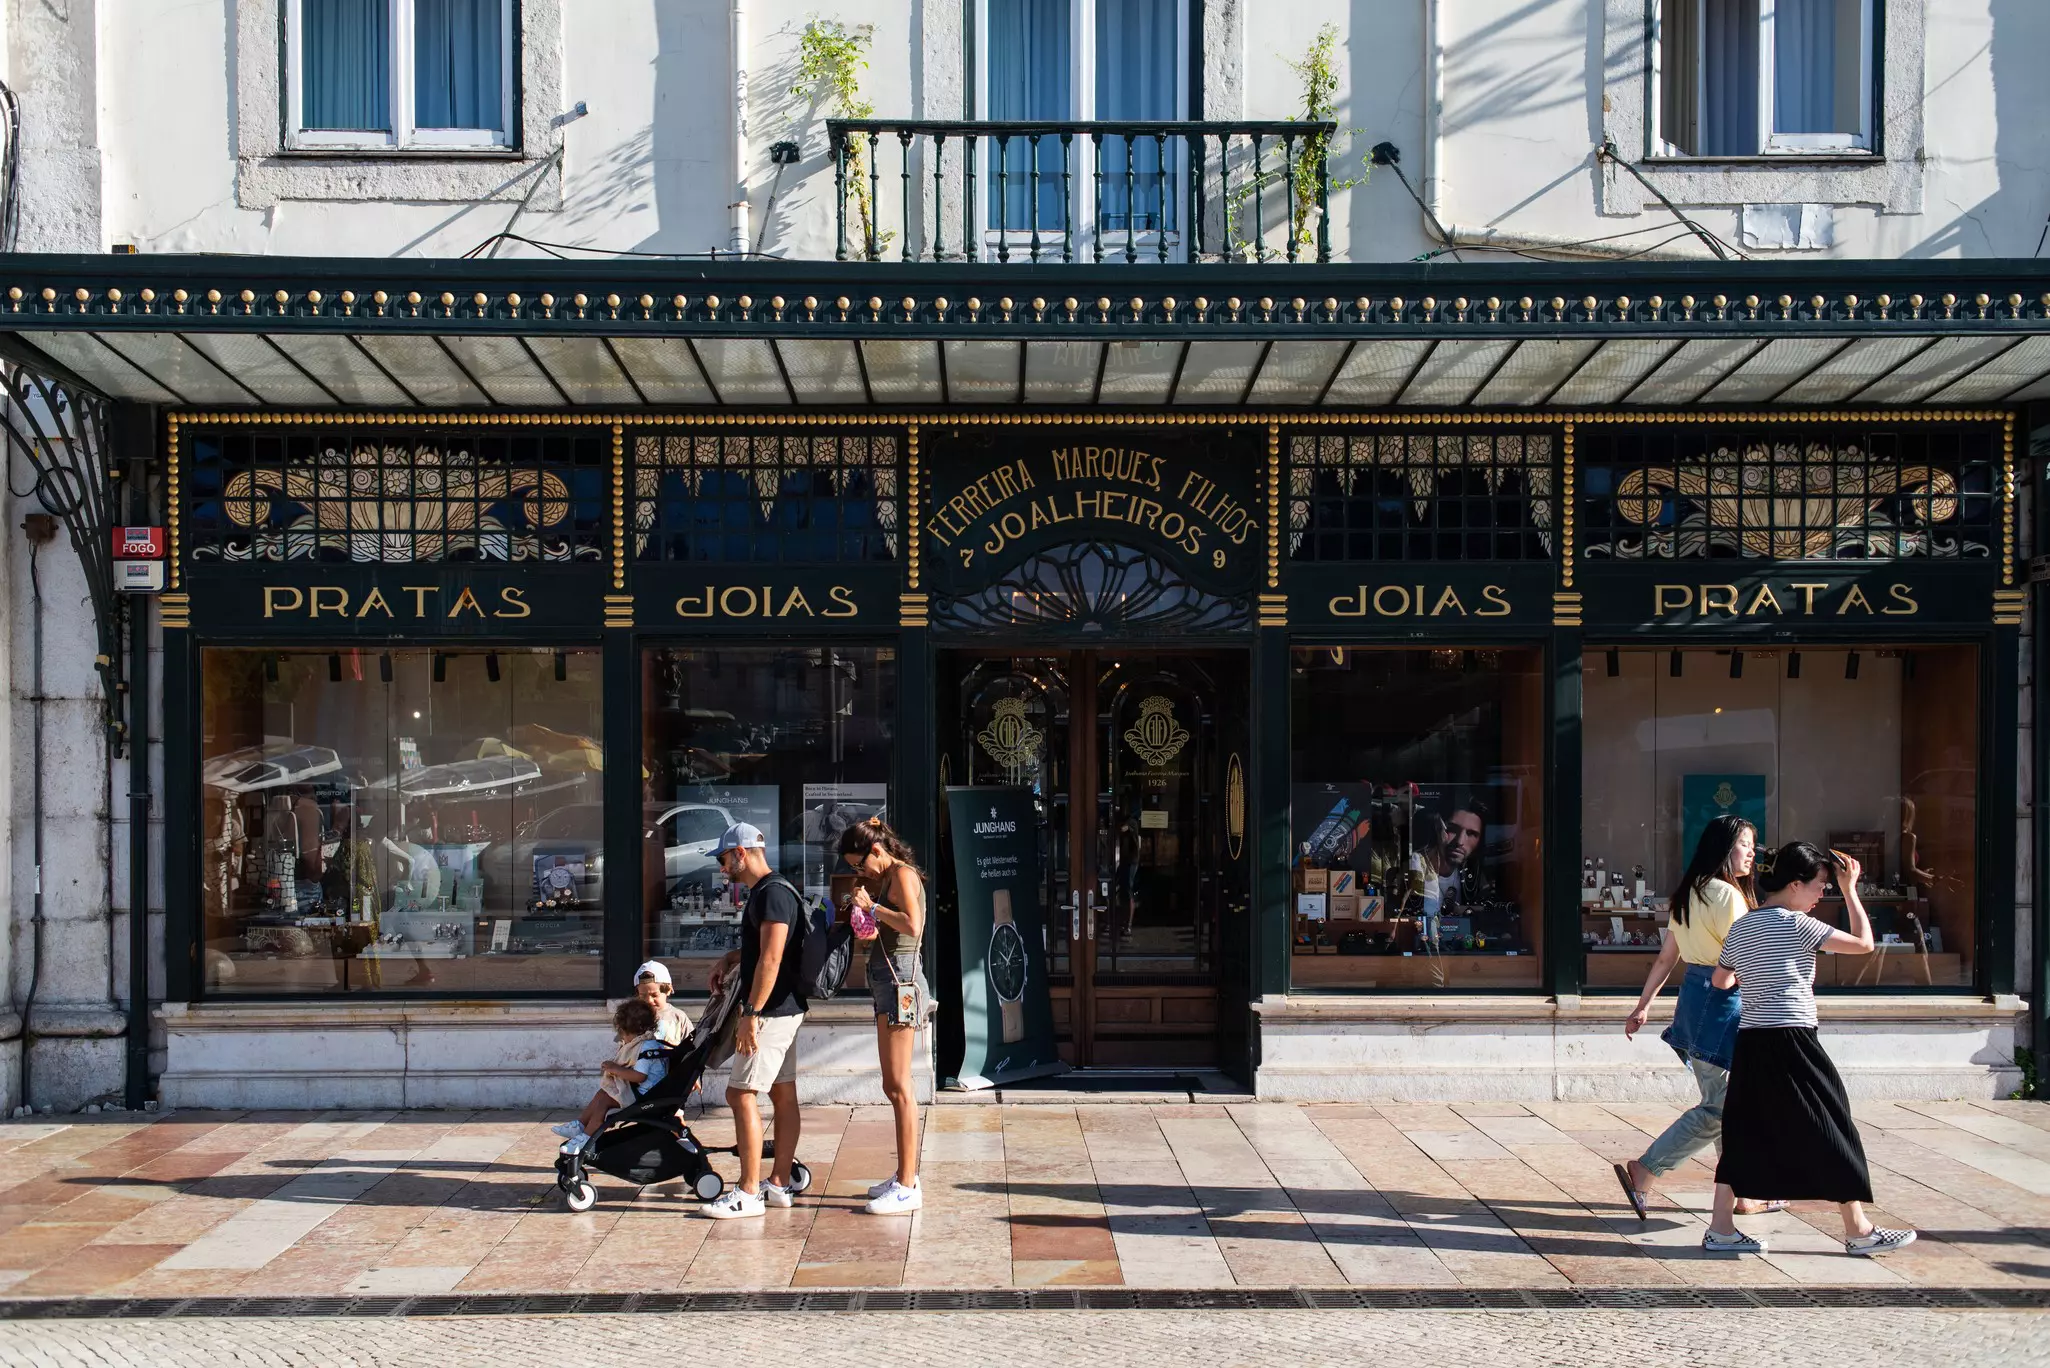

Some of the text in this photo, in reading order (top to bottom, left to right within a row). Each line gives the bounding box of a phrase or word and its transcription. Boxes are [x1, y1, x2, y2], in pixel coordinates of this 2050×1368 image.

[926, 446, 1260, 548] FERREIRA MARQUES, FILHOS
[983, 490, 1208, 556] JOALHEIROS
[122, 543, 156, 553] FOGO
[960, 548, 974, 568] 7
[1213, 549, 1227, 569] 9
[263, 586, 532, 619] PRATAS
[676, 586, 858, 617] JOIAS
[1328, 584, 1513, 617] JOIAS
[1654, 583, 1920, 616] PRATAS
[1148, 779, 1167, 787] 1926
[973, 821, 1016, 834] JUNGHANS
[976, 857, 982, 866] Es
[982, 857, 992, 868] gibt
[1001, 869, 1011, 877] auch
